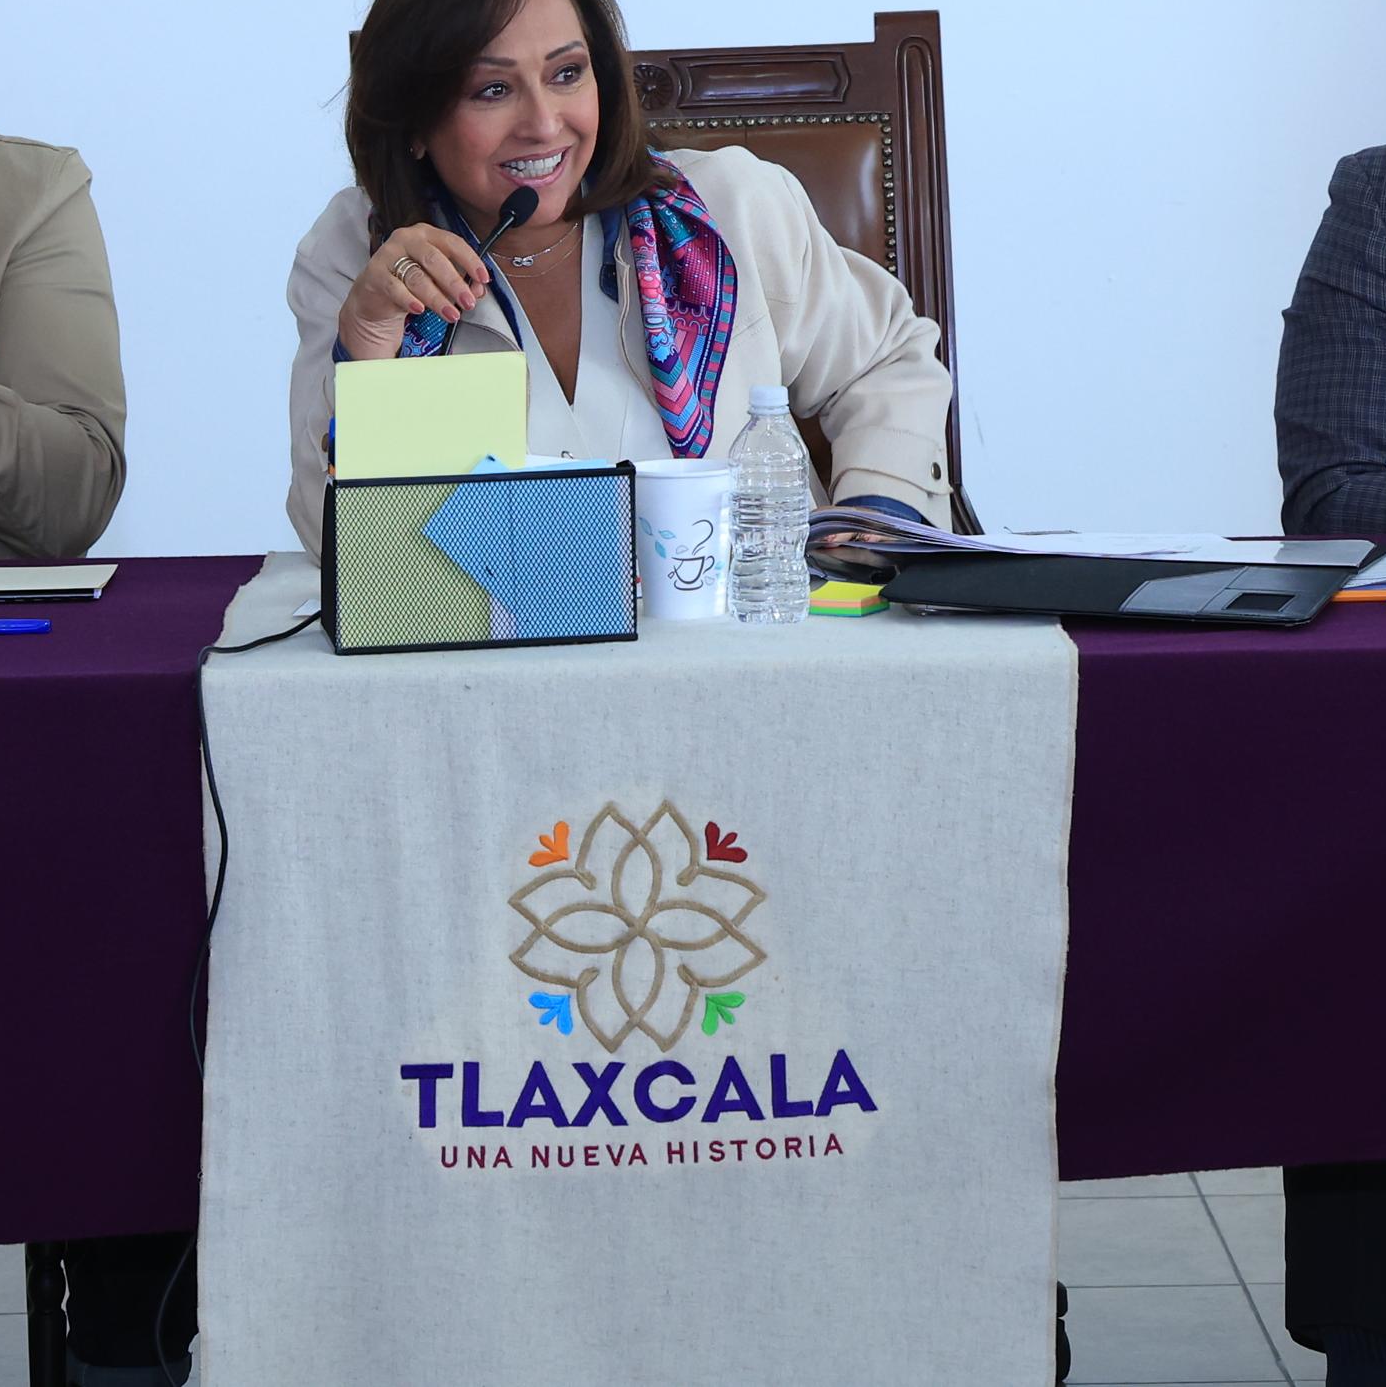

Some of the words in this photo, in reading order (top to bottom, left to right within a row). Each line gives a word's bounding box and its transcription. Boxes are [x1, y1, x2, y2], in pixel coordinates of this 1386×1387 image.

[400, 1049, 878, 1129] TLAXCALA
[441, 1146, 513, 1170] UNA
[531, 1143, 648, 1169] NUEVA
[667, 1132, 844, 1165] HISTORIA
